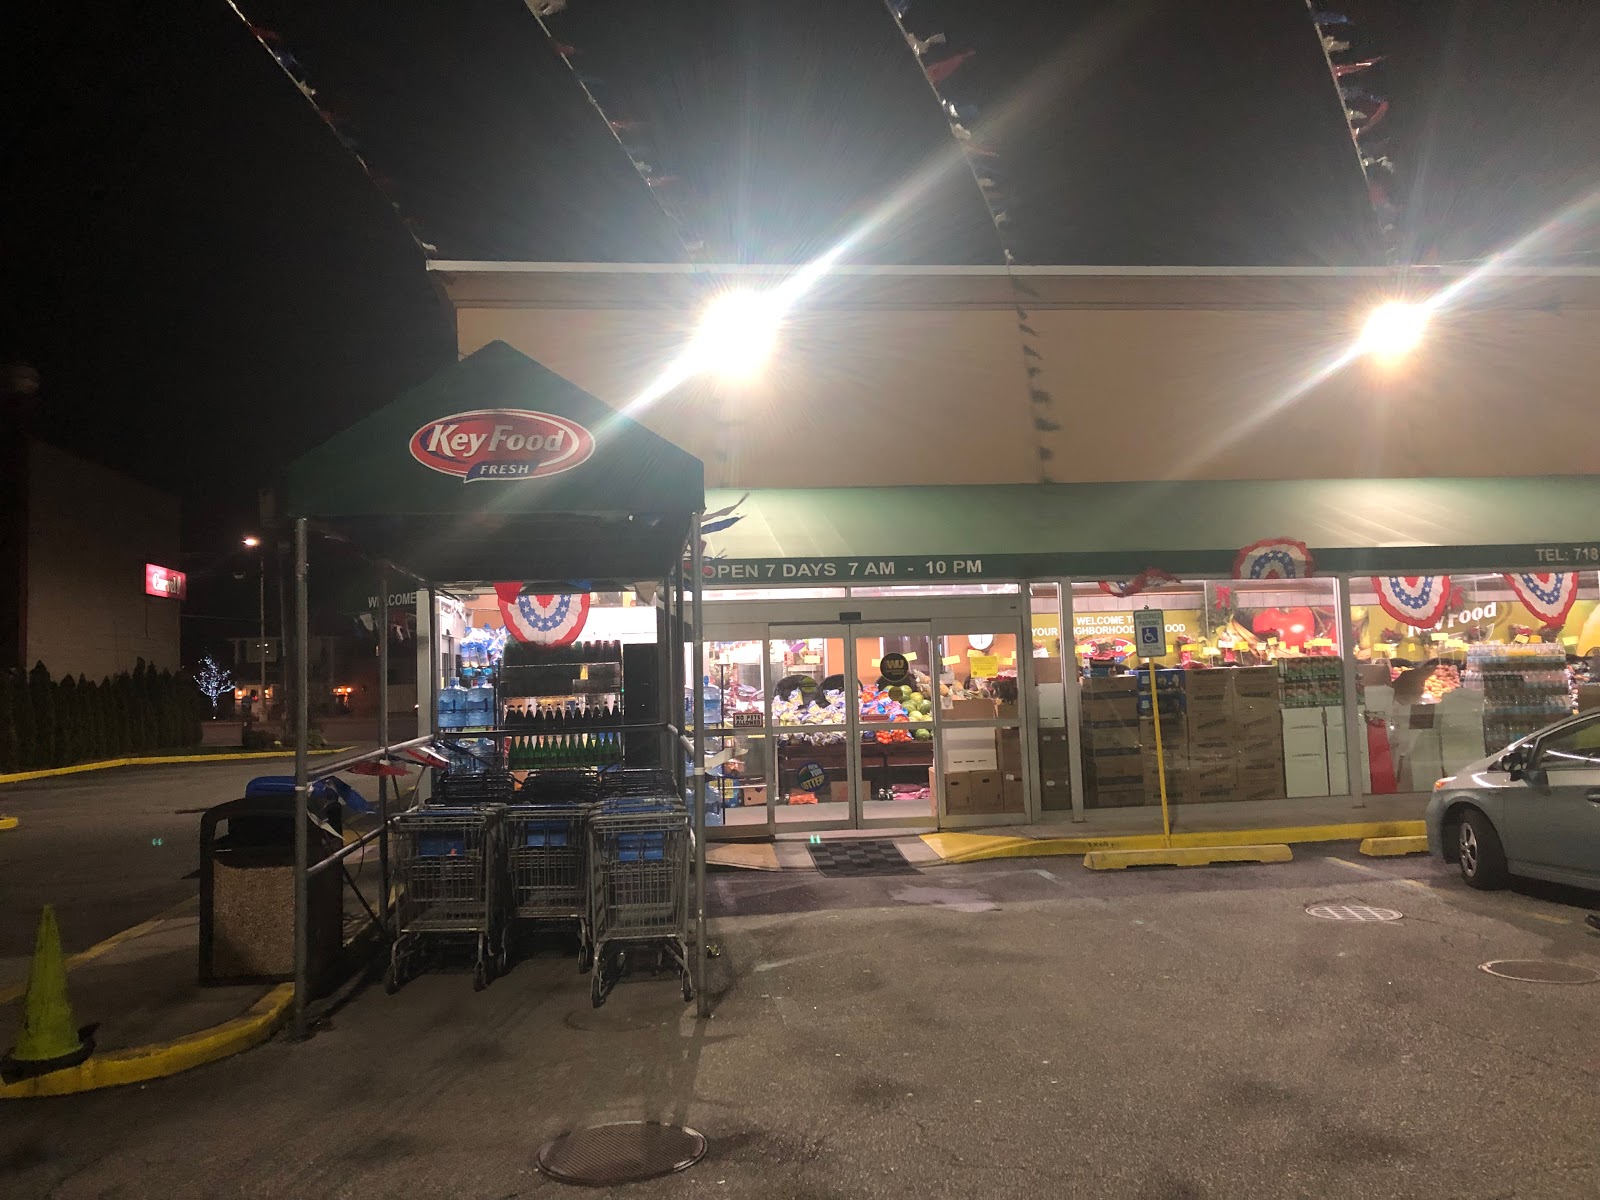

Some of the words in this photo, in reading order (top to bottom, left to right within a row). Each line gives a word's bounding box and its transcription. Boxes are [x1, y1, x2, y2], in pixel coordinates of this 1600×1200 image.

[426, 424, 489, 457] Key
[488, 425, 565, 452] Food
[479, 464, 529, 475] FRESH
[1535, 548, 1569, 561] TEL:
[1573, 547, 1599, 561] 718
[701, 564, 759, 579] OPEN
[765, 564, 776, 577] 7
[782, 563, 837, 577] DAYS
[848, 562, 859, 575] 7
[864, 562, 895, 575] AM
[925, 561, 947, 574] 10
[953, 560, 982, 573] PM
[367, 592, 417, 608] WCOME
[1076, 616, 1125, 625] WELCOME
[1032, 628, 1058, 637] YOUR
[1165, 624, 1186, 632] OOD
